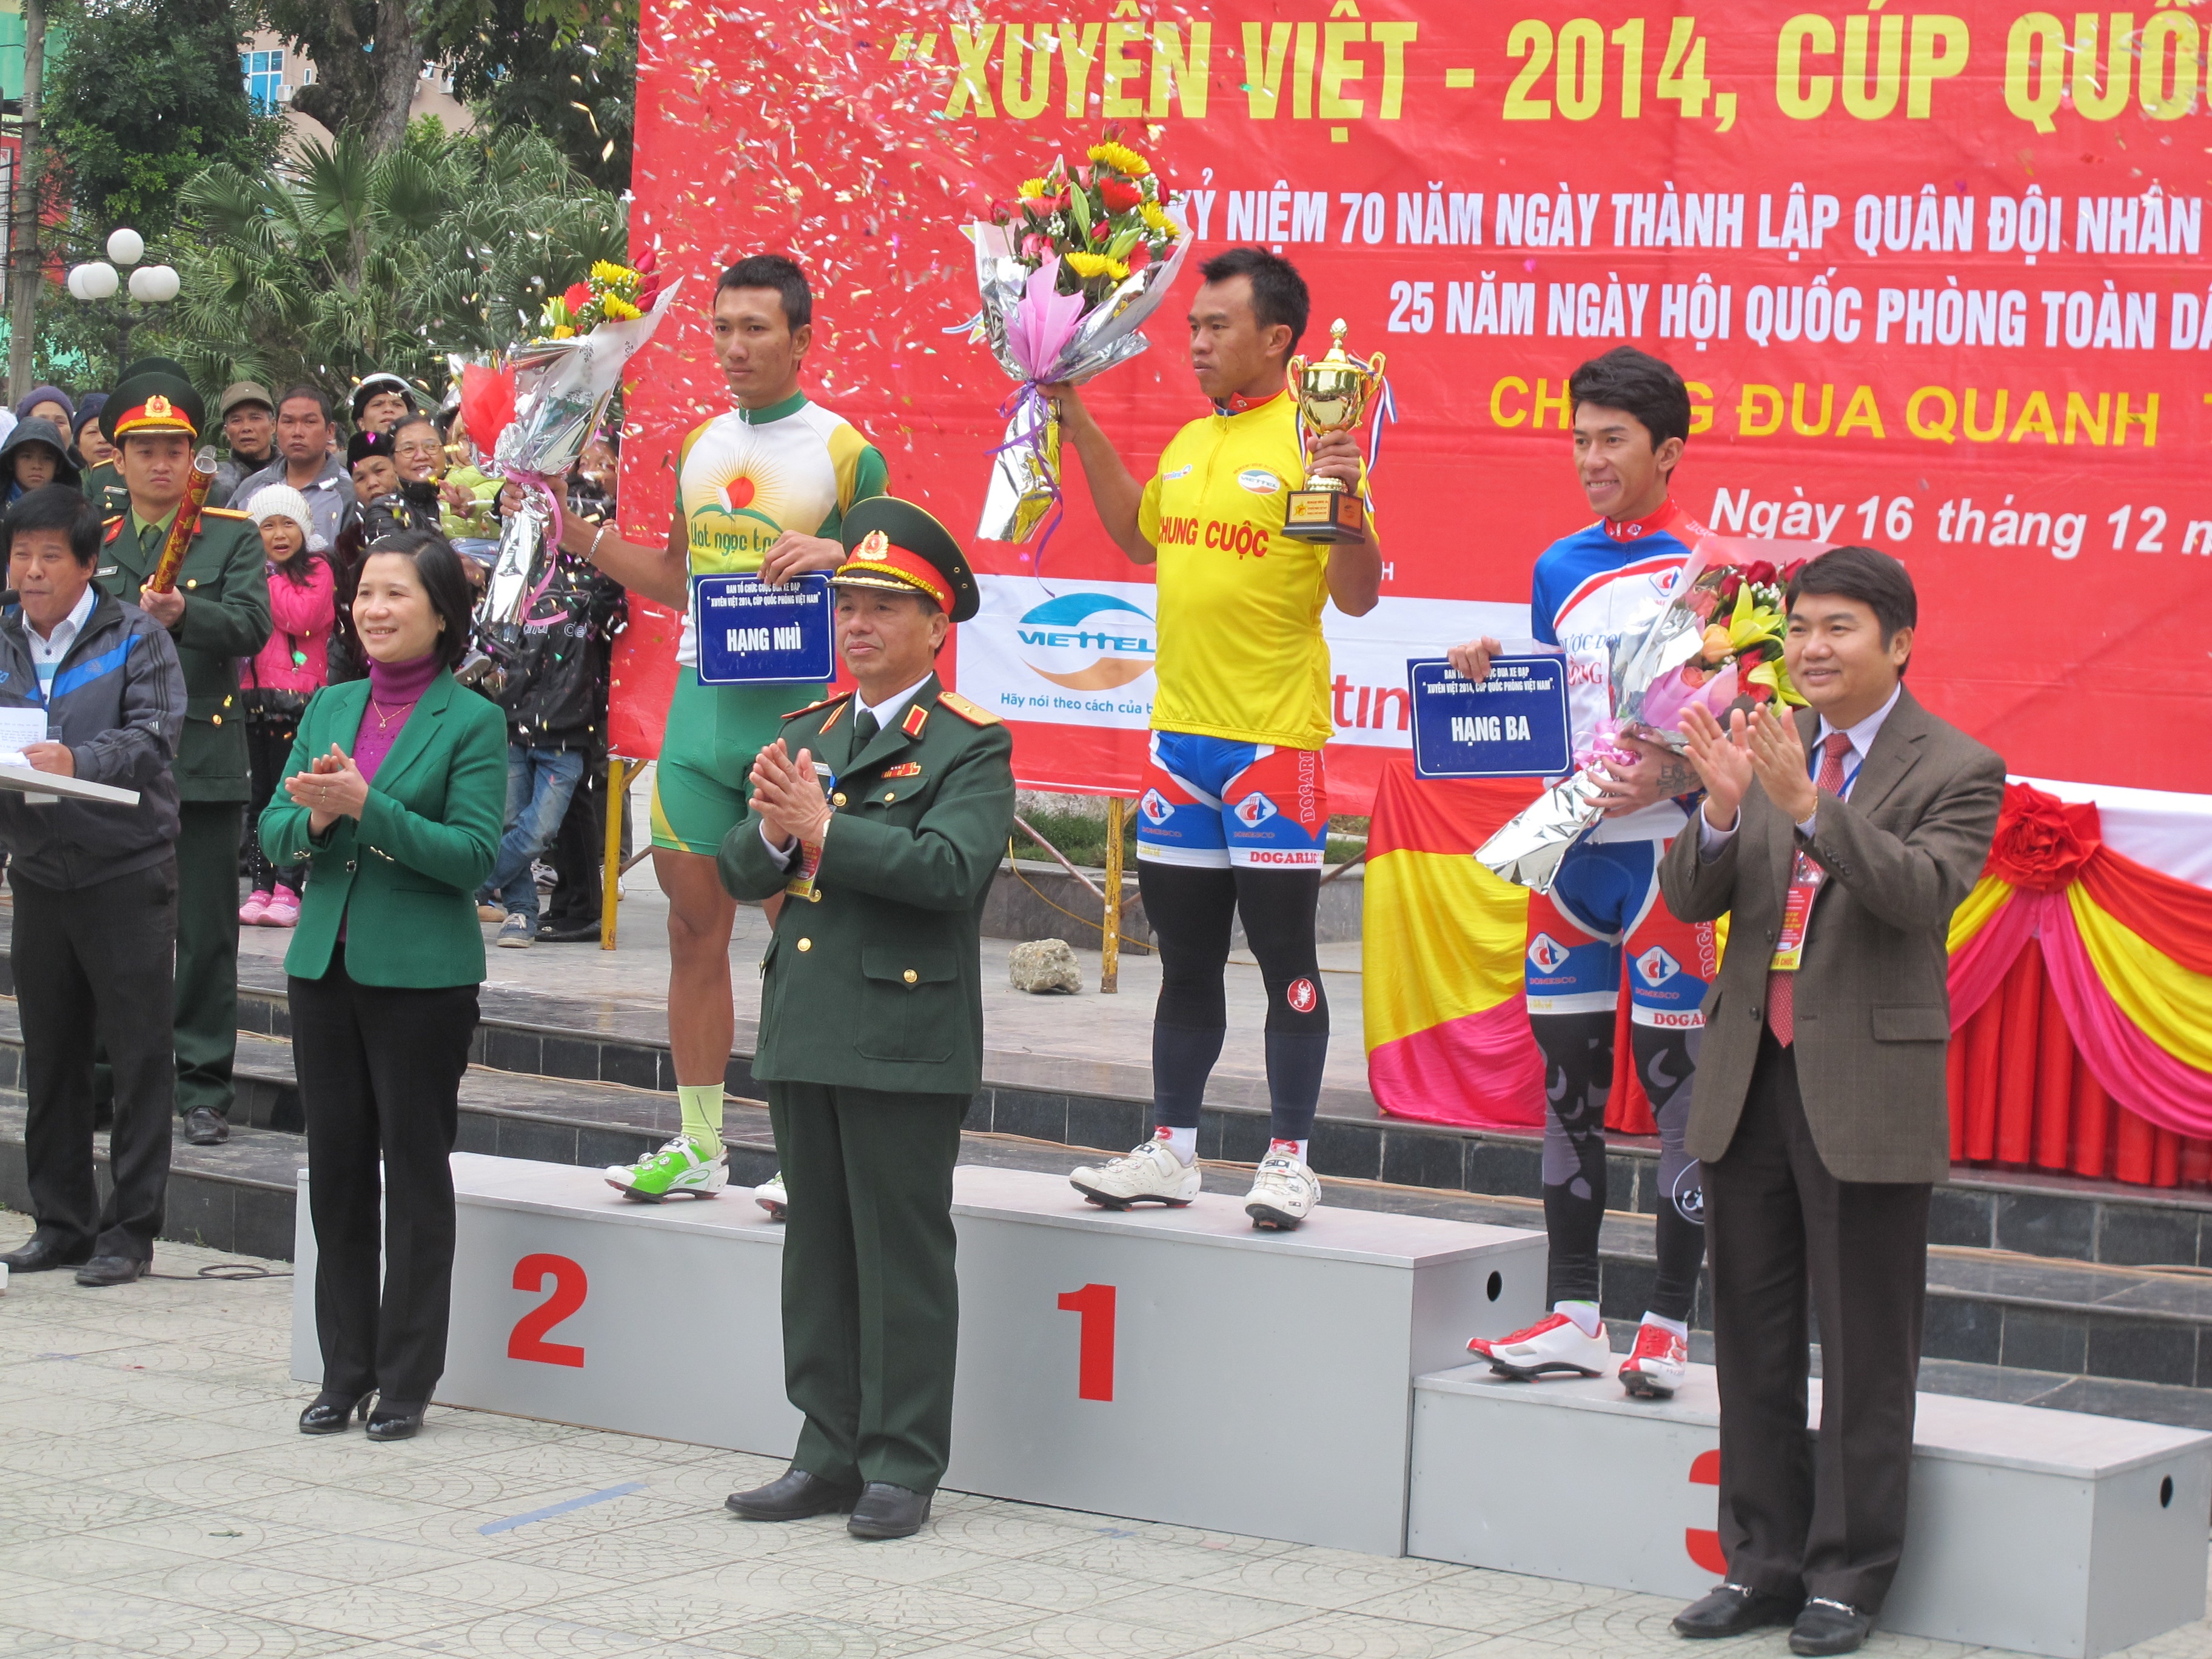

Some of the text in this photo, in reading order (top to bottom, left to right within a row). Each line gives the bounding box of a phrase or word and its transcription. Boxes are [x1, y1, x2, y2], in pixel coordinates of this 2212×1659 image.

[1241, 0, 1418, 142] VIỆT
[1502, 16, 1737, 132] 2014,
[1775, 0, 1970, 121] CÚP
[2004, 0, 2212, 134] QUỐ
[1227, 180, 1328, 253] NIỆM
[1339, 192, 1385, 243] 70
[1396, 180, 1483, 245] NĂM
[1495, 181, 1600, 247] NGÀY
[1611, 181, 1744, 247] THÀNH
[1757, 182, 1840, 261] LẬP
[1854, 183, 1974, 257] QUÂN
[1988, 184, 2062, 265] ĐỘI
[2076, 184, 2202, 254] NHÂN
[1387, 280, 1434, 333] 25
[1446, 270, 1535, 335] NĂM
[1547, 271, 1649, 337] NGÀY
[1660, 273, 1731, 351] HỘI
[1745, 267, 1862, 347] QUỐC
[1875, 276, 2027, 347] PHÒNG
[2041, 280, 2157, 350] TOÀN
[1490, 375, 1714, 435] CHG
[1735, 383, 1886, 440] ĐUA
[1906, 386, 2160, 447] QUANH
[1205, 520, 1269, 560] CUỘC
[1709, 486, 1845, 542] Ngày
[1856, 495, 1914, 541] 16
[1938, 494, 2086, 560] tháng
[2107, 504, 2167, 553] 12
[726, 622, 802, 657] HẠNG NHÌ
[1000, 692, 1025, 708] Hãy
[1029, 695, 1049, 707] nói
[1054, 697, 1082, 709] theo
[1085, 699, 1113, 712] cách
[1118, 700, 1142, 714] của
[1451, 716, 1530, 746] HẠNG BA
[508, 1253, 588, 1369] 2
[1057, 1282, 1116, 1403] 1
